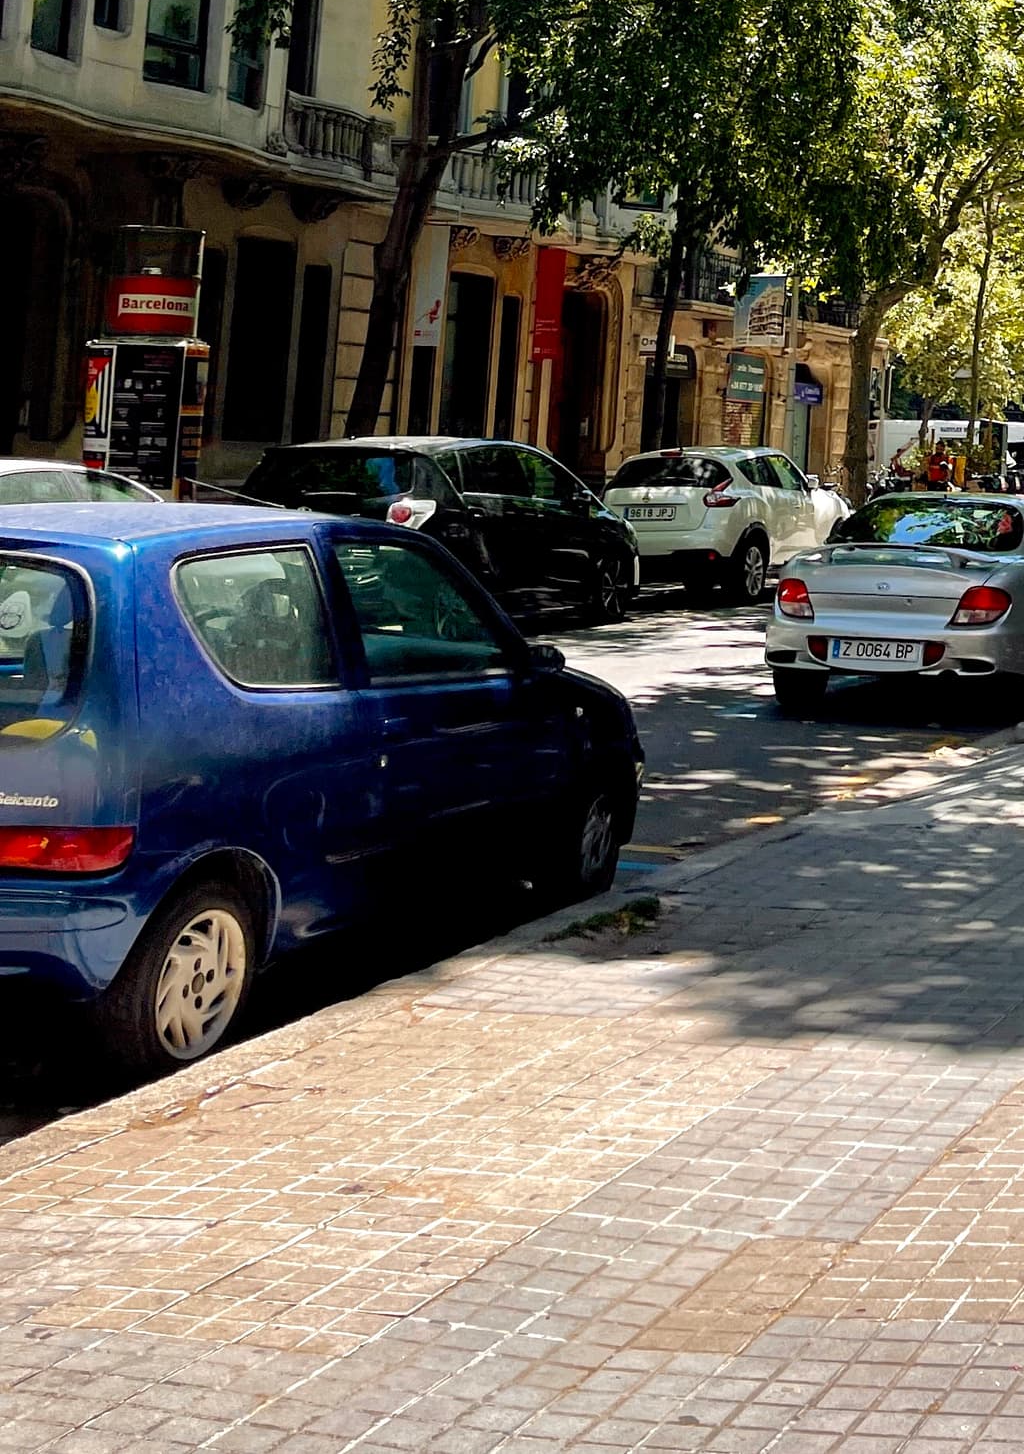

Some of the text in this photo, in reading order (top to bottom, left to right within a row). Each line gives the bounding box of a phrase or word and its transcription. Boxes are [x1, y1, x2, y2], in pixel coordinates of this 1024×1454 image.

[121, 297, 190, 312] Barcelona
[655, 508, 674, 518] JPJ
[842, 641, 914, 659] Z 0064 BP
